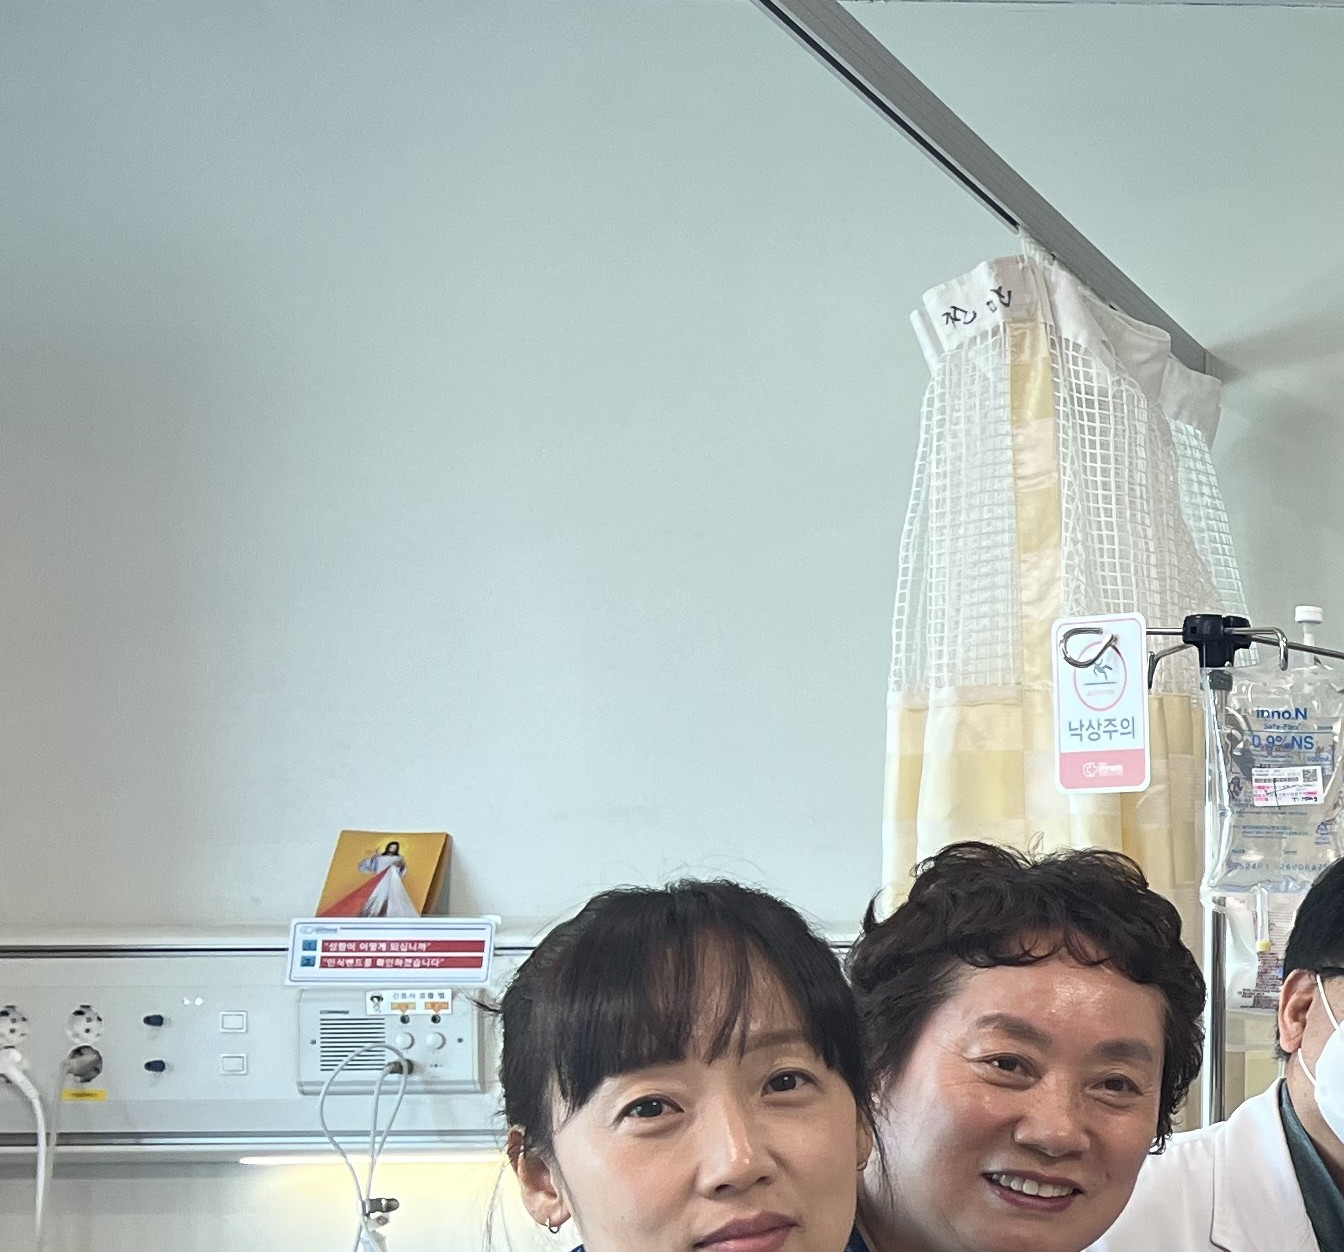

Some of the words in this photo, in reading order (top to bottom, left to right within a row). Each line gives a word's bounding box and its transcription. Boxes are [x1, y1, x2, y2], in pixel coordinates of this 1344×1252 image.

[1257, 707, 1308, 720] inno.N
[1069, 716, 1135, 742] 낙상주의
[1292, 736, 1314, 750] NS
